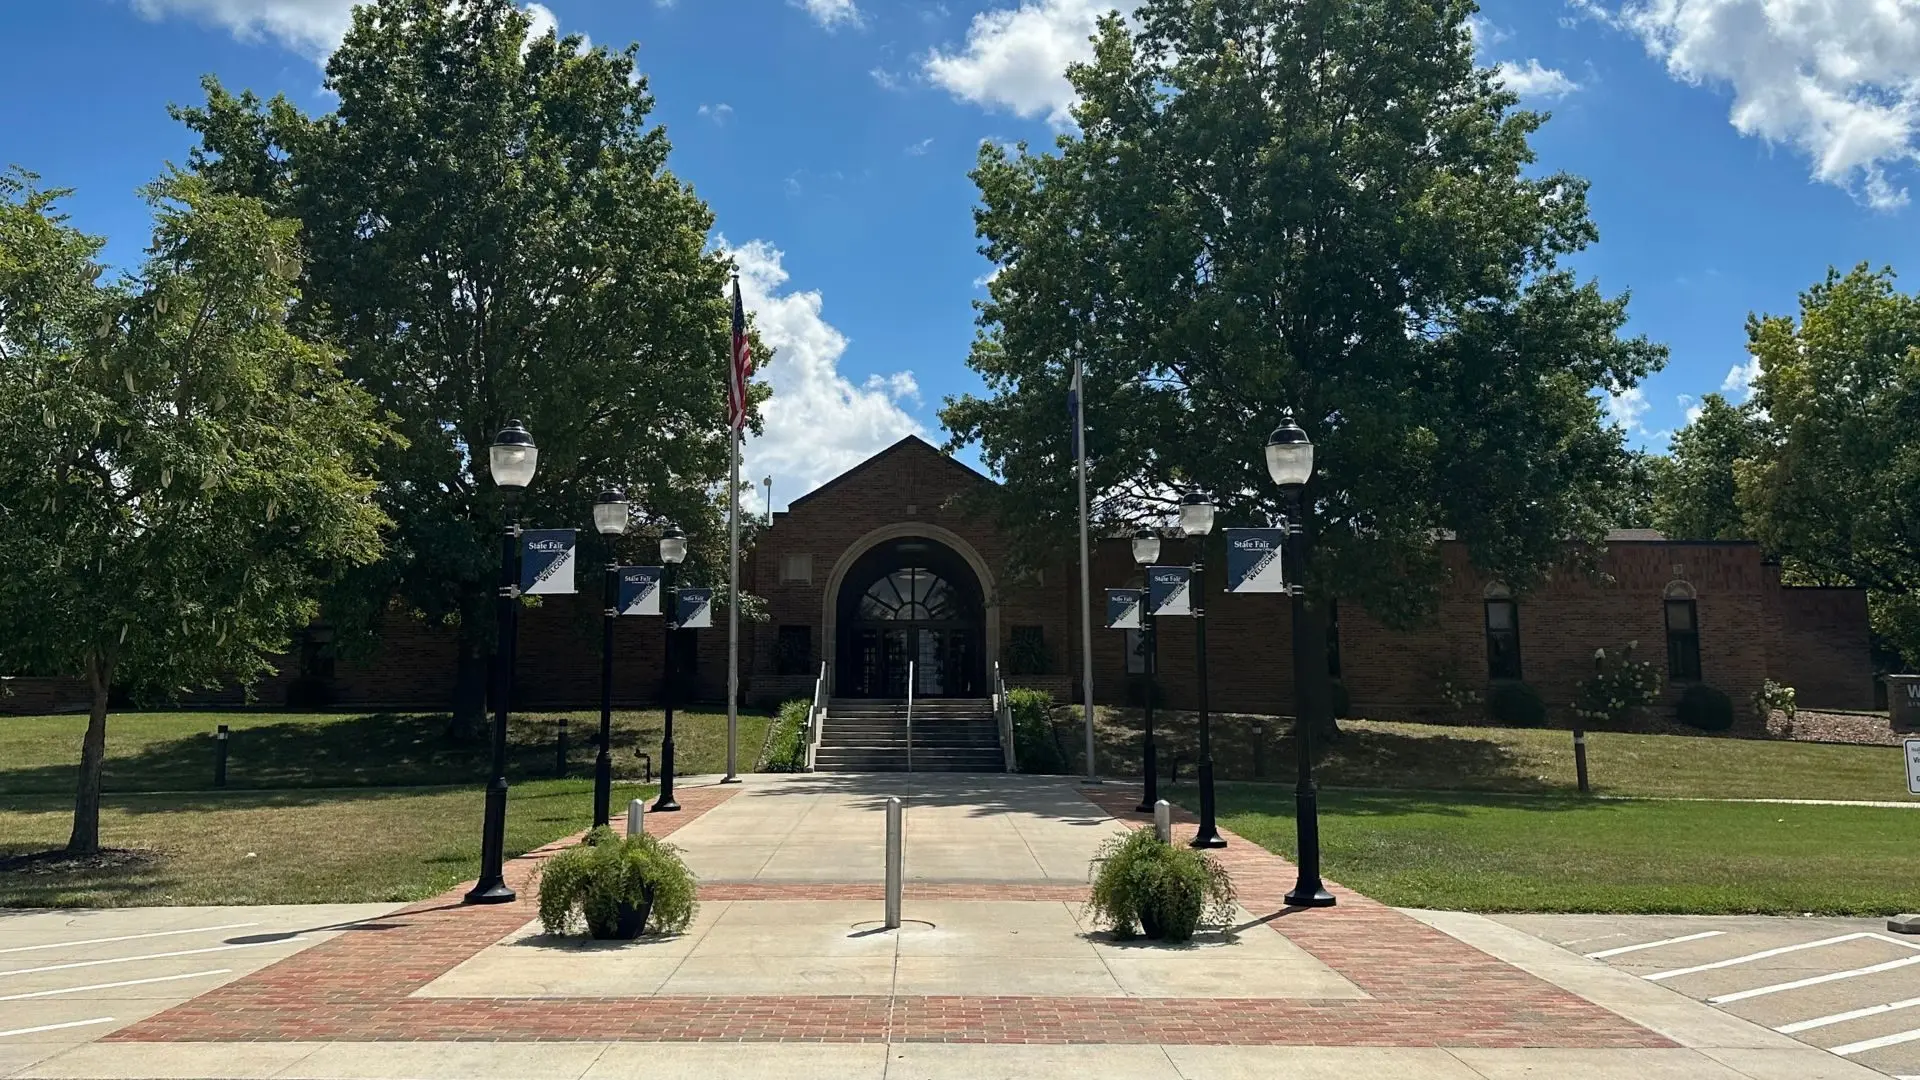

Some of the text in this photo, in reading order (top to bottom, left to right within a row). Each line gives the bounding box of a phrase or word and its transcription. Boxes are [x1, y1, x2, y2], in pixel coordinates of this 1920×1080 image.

[528, 541, 564, 550] State Fair
[1234, 540, 1270, 548] State Fair
[540, 552, 571, 582] WELCOME
[1248, 551, 1278, 581] WELCOME
[634, 584, 656, 606] WELCOME
[1165, 585, 1187, 606] WELCOME
